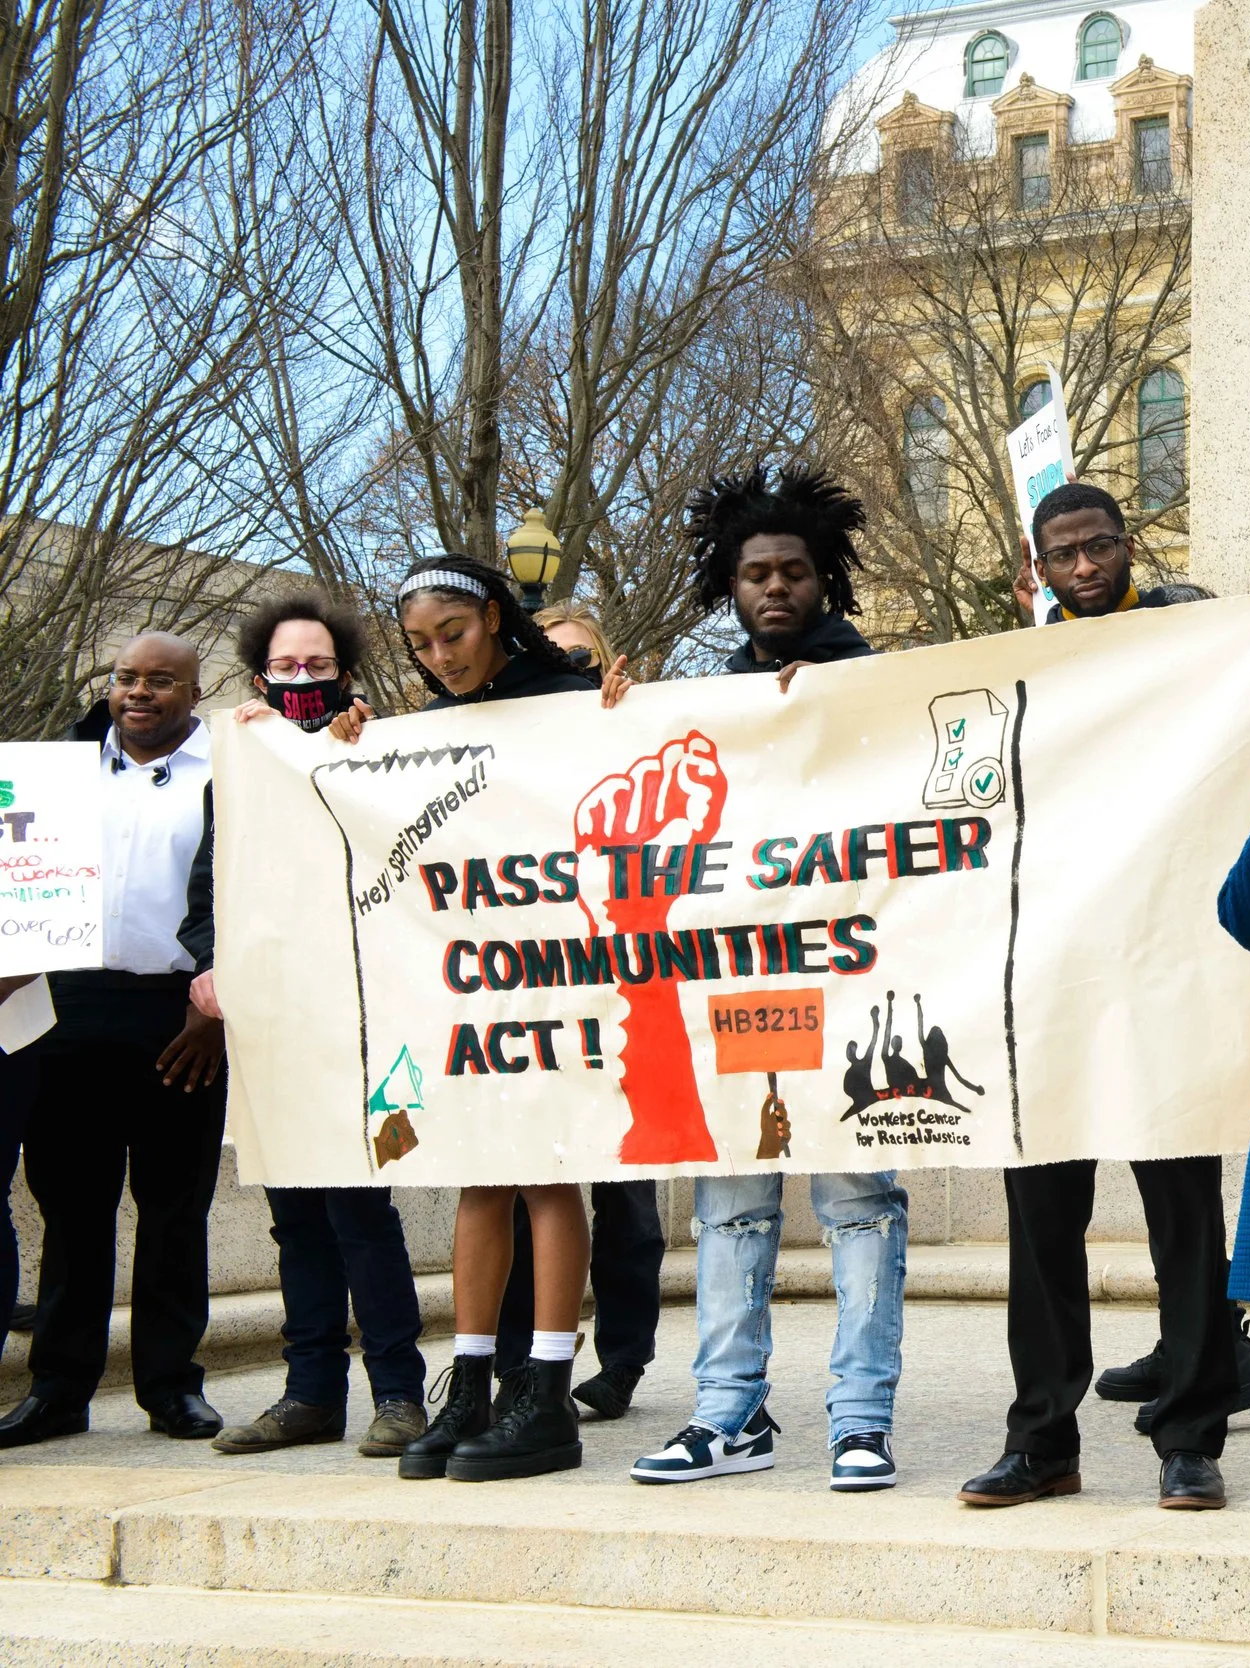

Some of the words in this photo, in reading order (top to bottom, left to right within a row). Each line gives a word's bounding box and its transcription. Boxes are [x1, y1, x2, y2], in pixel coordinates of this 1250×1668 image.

[284, 690, 325, 719] SAFER
[418, 850, 580, 912] PASS
[599, 841, 733, 897] THE
[746, 816, 992, 890] SAFER
[355, 867, 396, 917] Hey!
[1, 918, 52, 936] Over
[47, 922, 97, 947] 60%
[442, 913, 879, 994] COMMUNITIES
[713, 1005, 820, 1034] HB3215
[857, 1111, 915, 1127] Workers
[916, 1108, 962, 1126] Center
[877, 1127, 923, 1147] Racial
[924, 1128, 972, 1146] Justice
